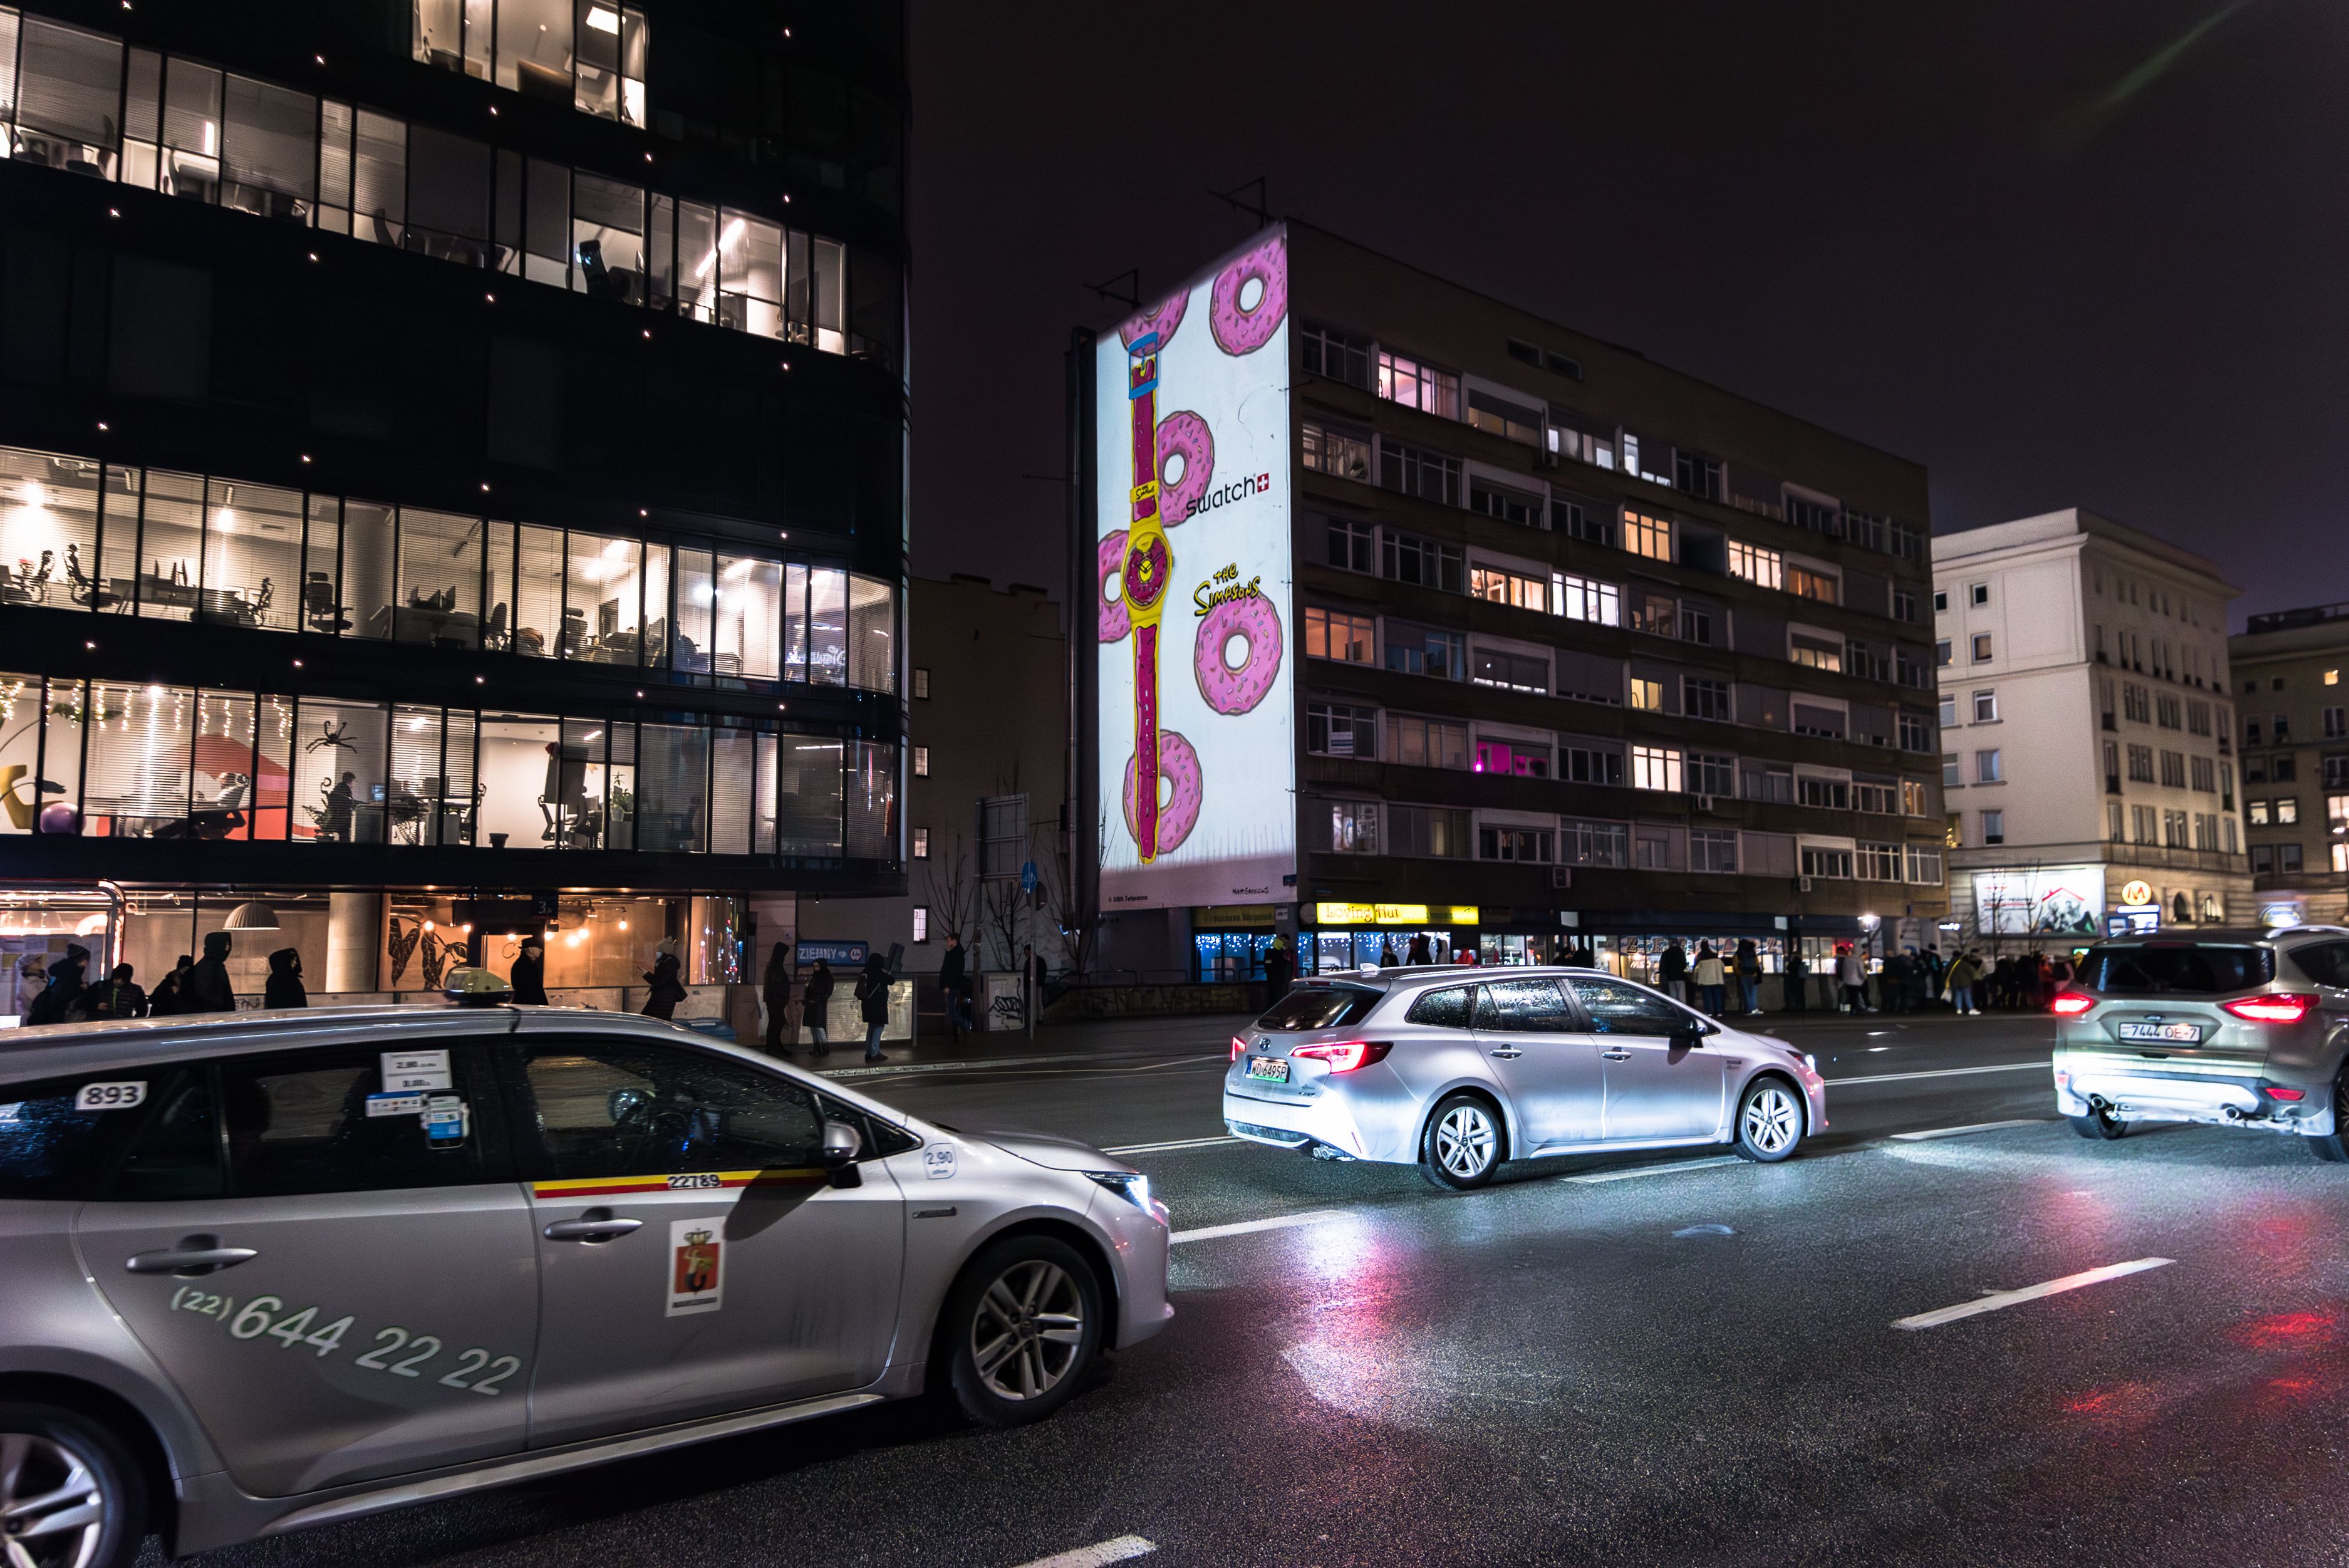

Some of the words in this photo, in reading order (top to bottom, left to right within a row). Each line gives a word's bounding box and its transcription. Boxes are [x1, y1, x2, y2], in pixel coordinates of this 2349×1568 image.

[1186, 476, 1255, 517] swatch
[1326, 905, 1372, 922] Loving
[1376, 906, 1399, 918] Hut
[2132, 1025, 2160, 1037] 7444
[86, 1086, 138, 1104] 893
[668, 1174, 720, 1188] 22789
[171, 1286, 232, 1322] (22)
[230, 1295, 355, 1357] 644
[355, 1326, 442, 1378] 22
[438, 1347, 522, 1396] 22
